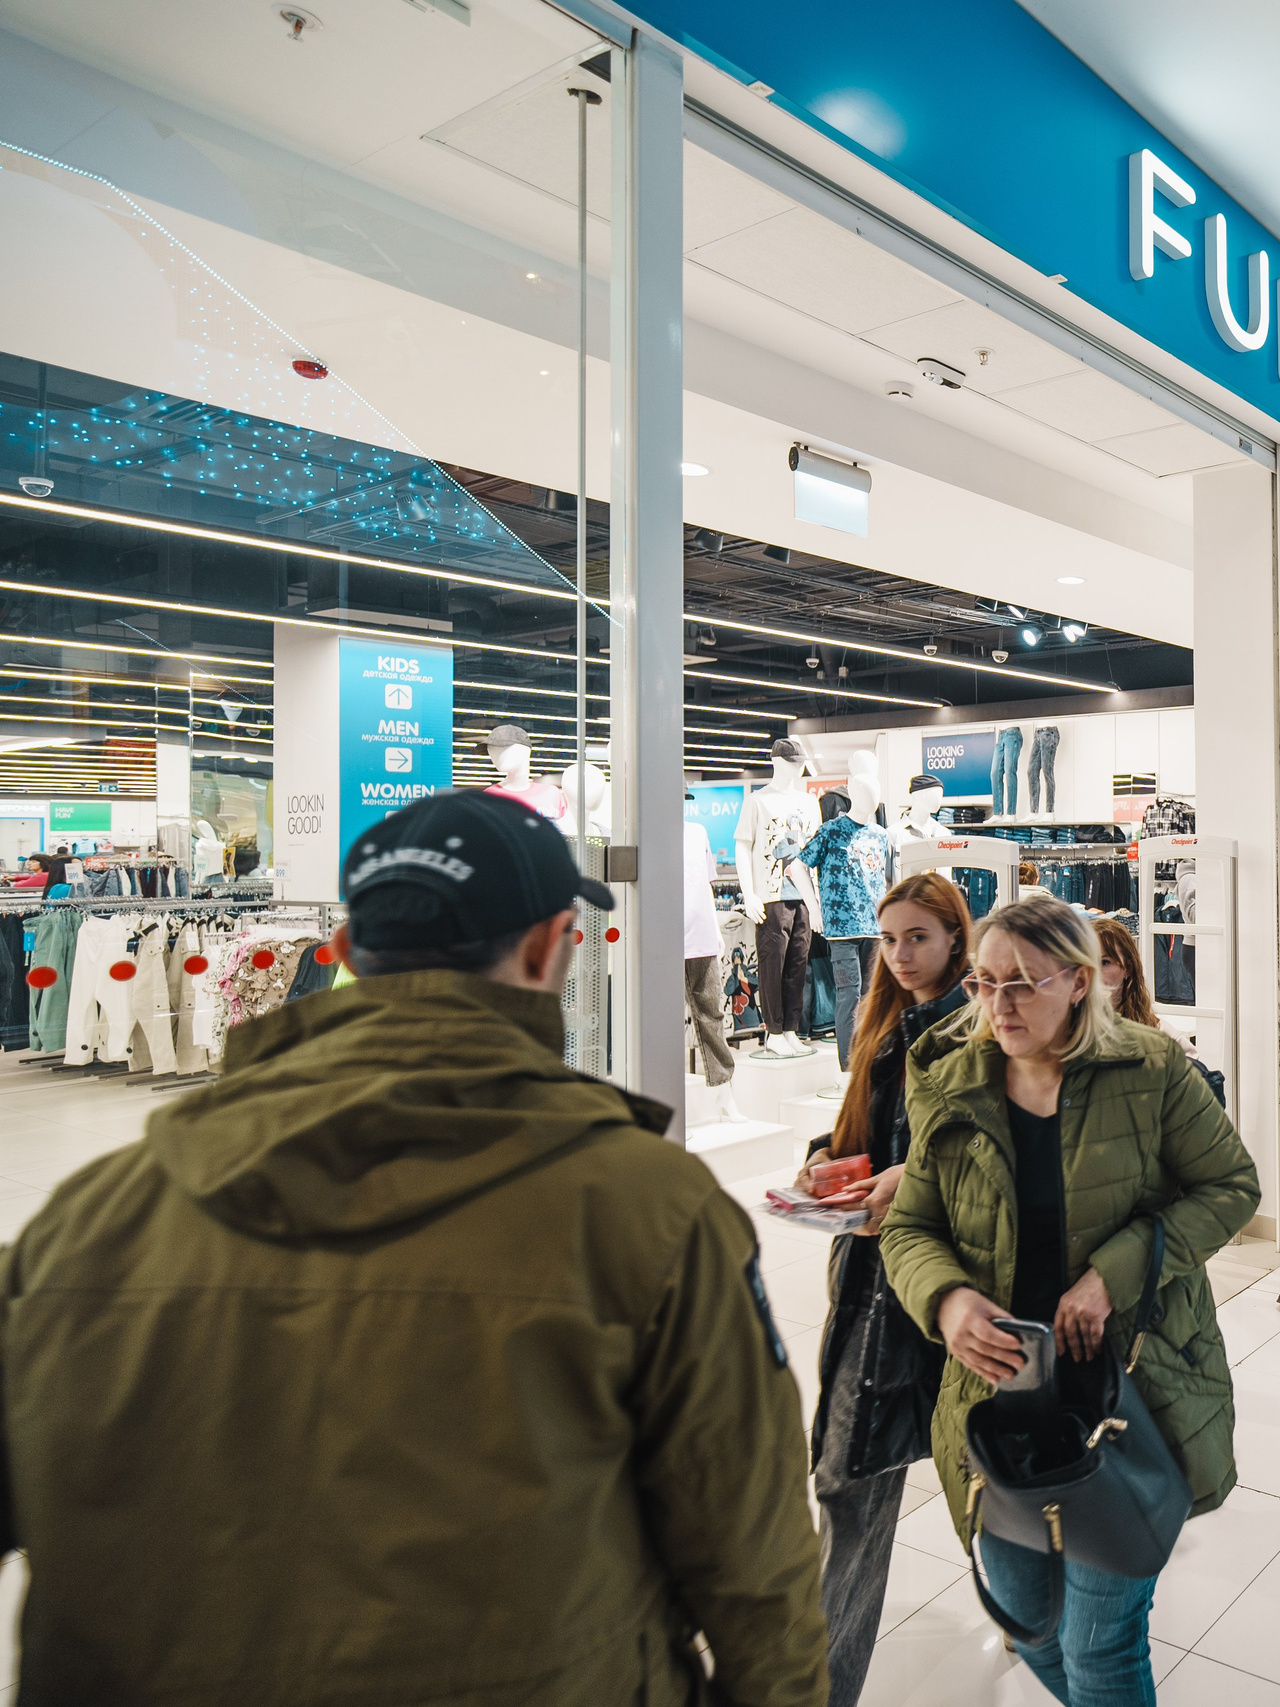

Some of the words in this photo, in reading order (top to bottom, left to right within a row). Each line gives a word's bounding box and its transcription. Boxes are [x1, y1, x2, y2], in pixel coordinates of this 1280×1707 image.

[377, 655, 420, 674] KIDS
[363, 670, 398, 680] детская
[400, 674, 433, 683] одежда
[378, 719, 419, 736] MEN
[361, 734, 400, 743] мужская
[401, 736, 434, 745] одежда
[926, 745, 964, 758] LOOKING
[927, 758, 955, 770] GOOD!
[360, 782, 435, 798] WOMEN
[287, 793, 324, 814] LOOKIN
[361, 798, 400, 806] женская
[711, 801, 739, 816] DAY
[287, 815, 321, 835] GOOD!
[937, 841, 964, 850] Checkpoint
